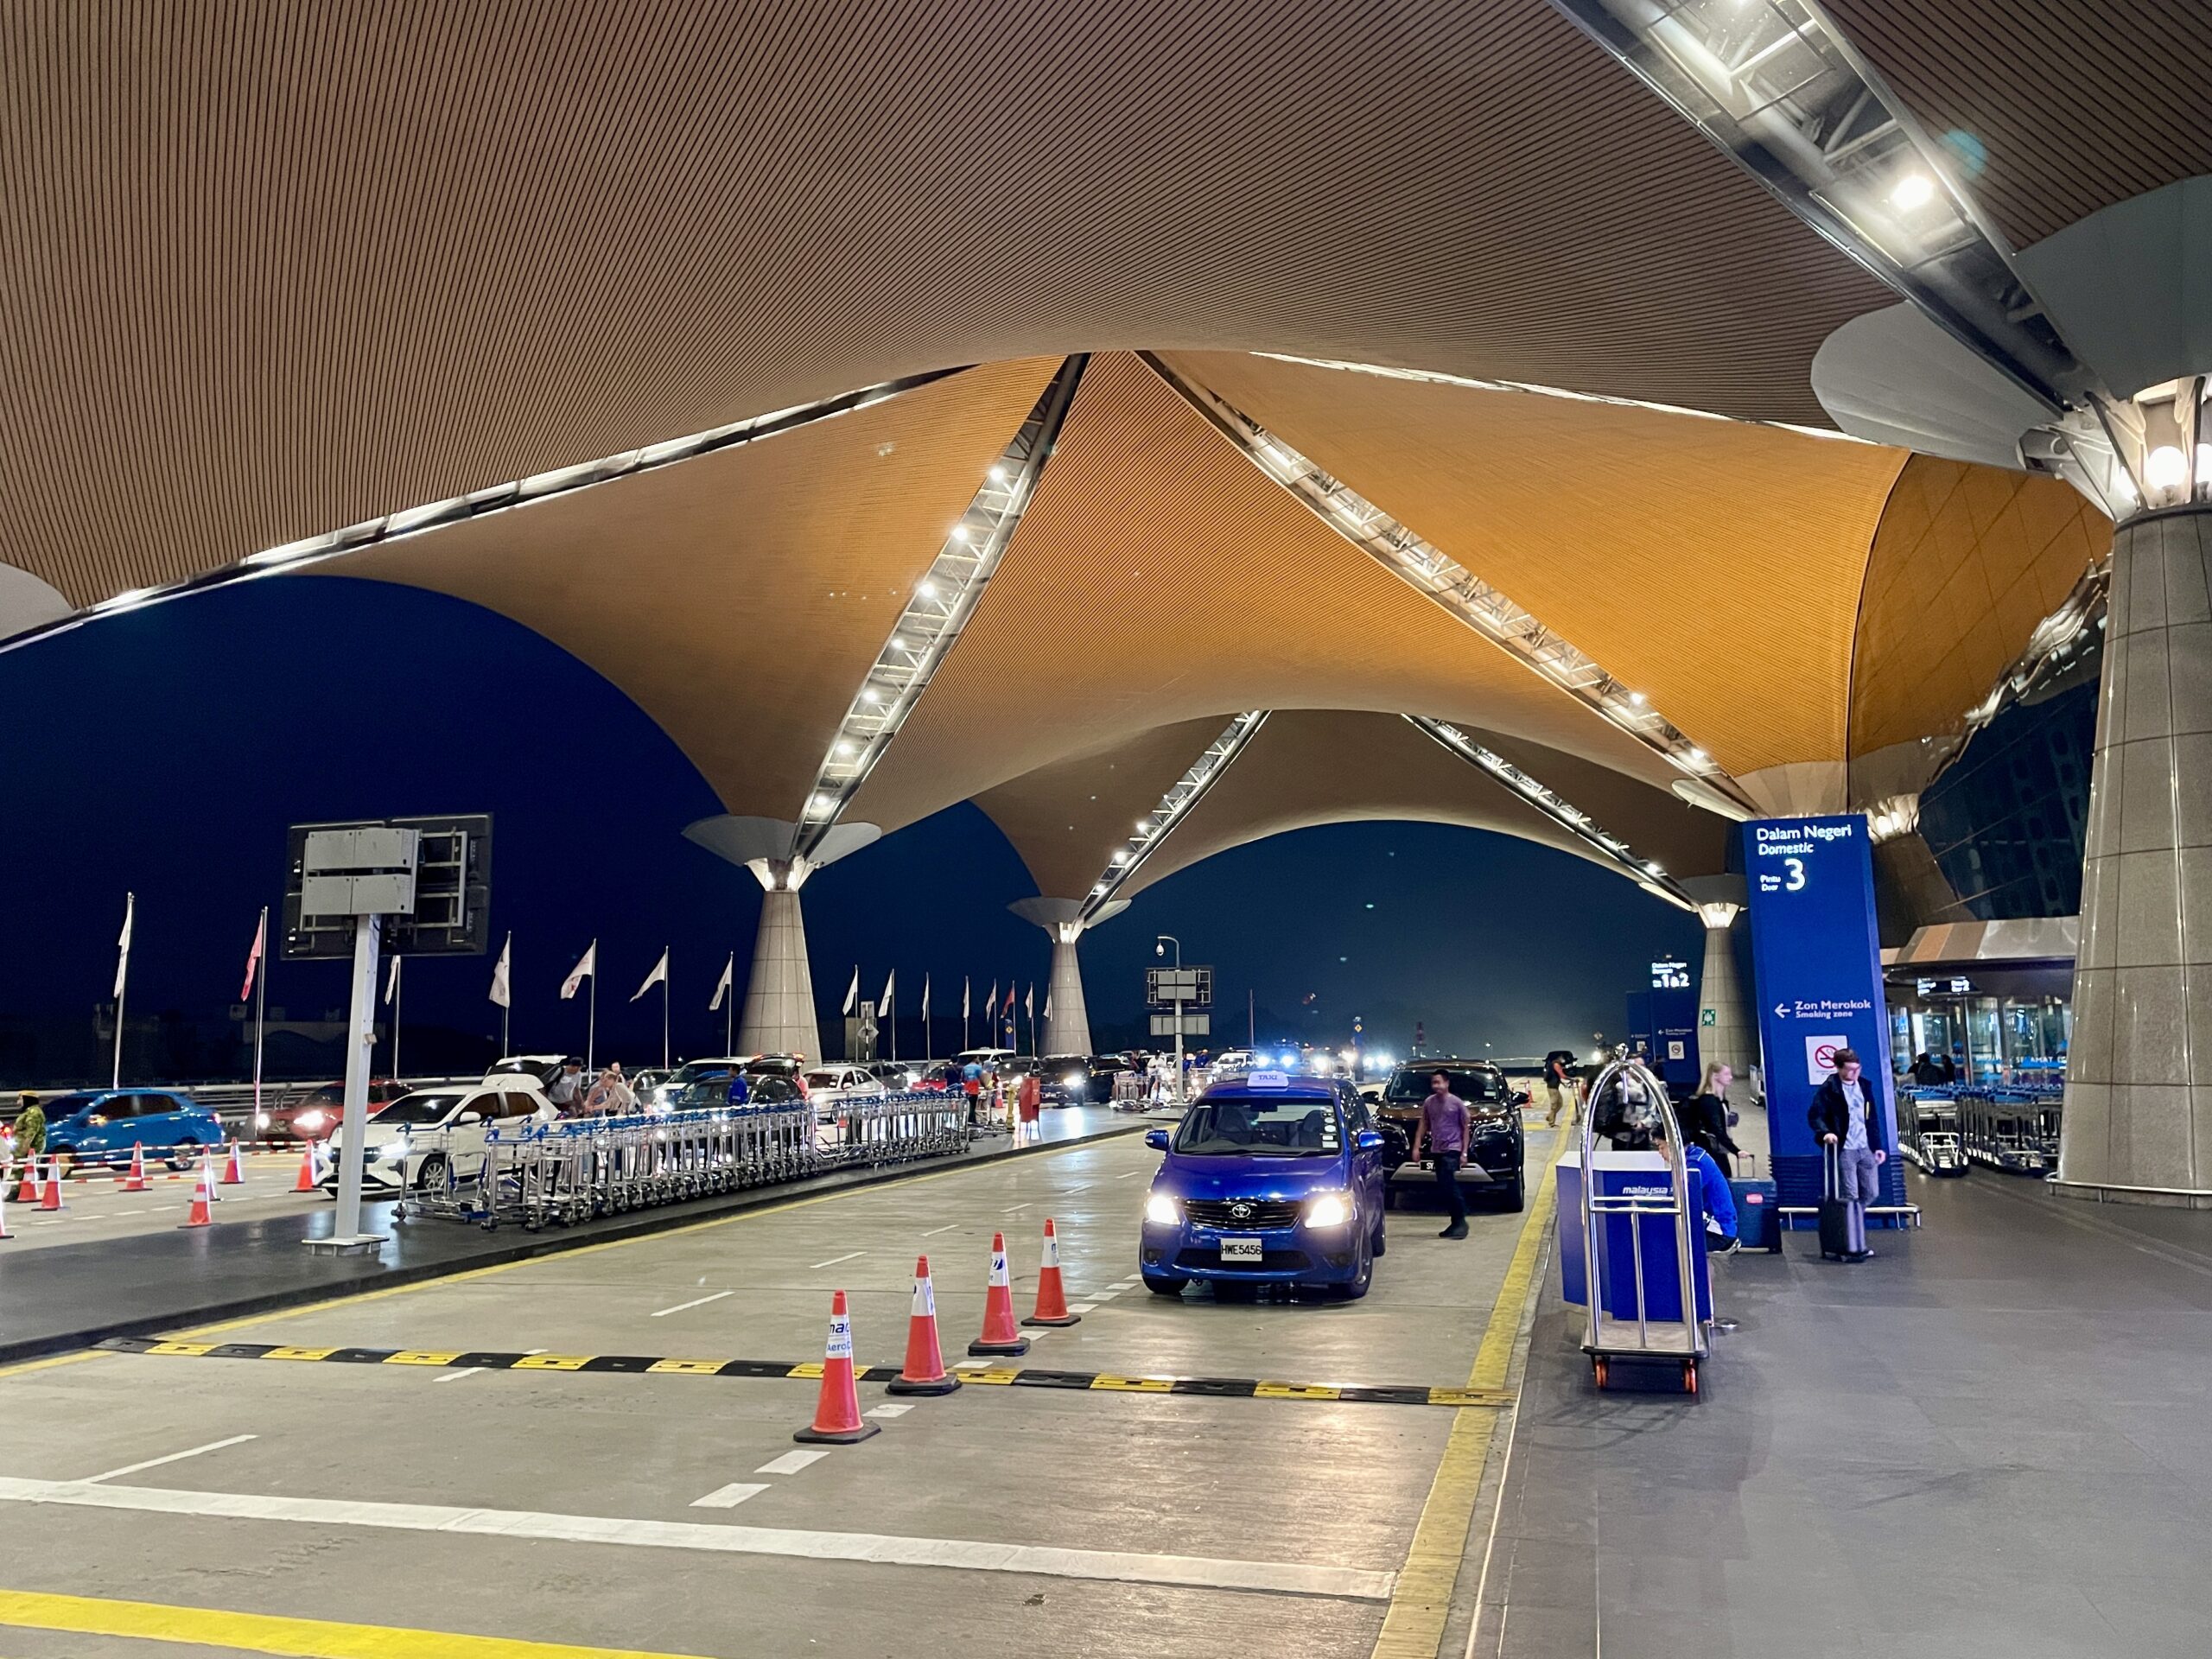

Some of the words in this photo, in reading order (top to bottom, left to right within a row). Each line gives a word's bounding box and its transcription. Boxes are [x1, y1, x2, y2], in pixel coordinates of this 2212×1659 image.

[1757, 827, 1801, 841] Dalam
[1803, 824, 1852, 841] Negeri
[1758, 842, 1814, 855] Domestic
[1784, 858, 1805, 891] 3
[1795, 1001, 1818, 1010] Zon
[1821, 999, 1872, 1010] Merokok
[1796, 1010, 1831, 1020] Smoking
[1623, 1185, 1669, 1197] malaysia
